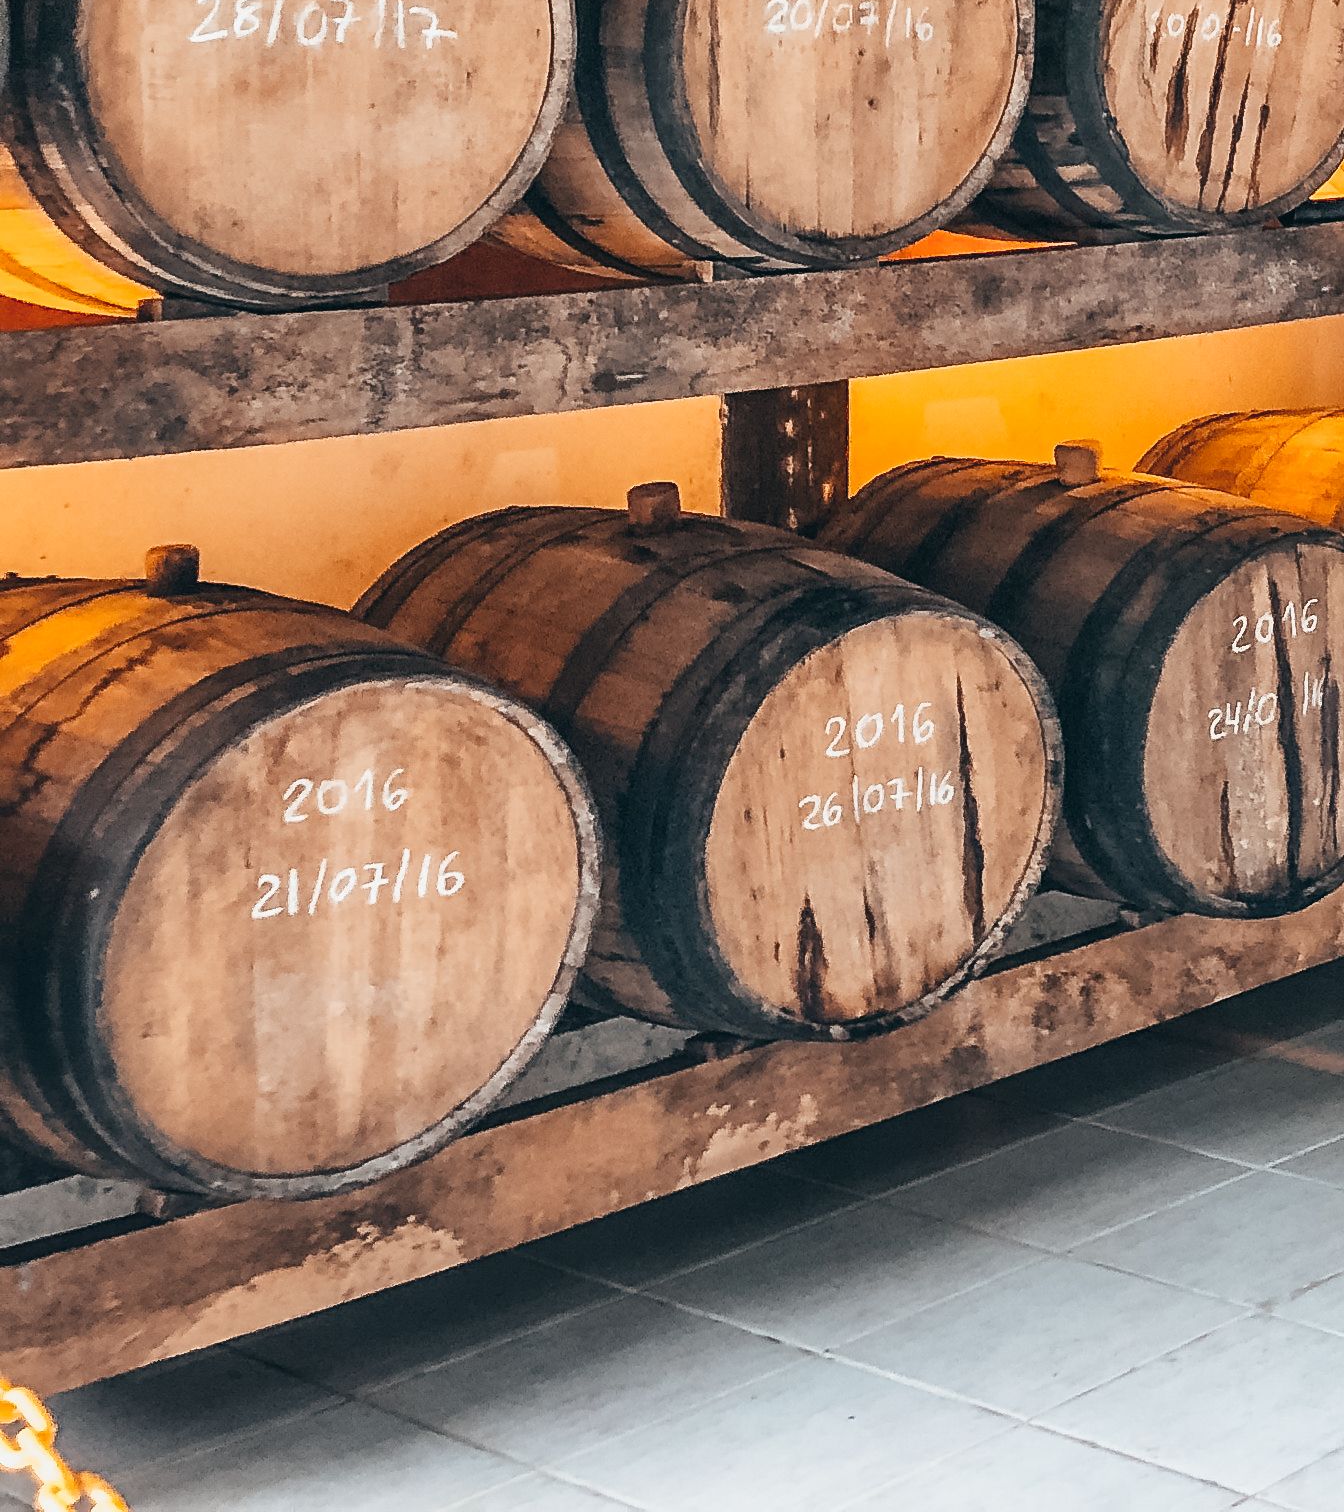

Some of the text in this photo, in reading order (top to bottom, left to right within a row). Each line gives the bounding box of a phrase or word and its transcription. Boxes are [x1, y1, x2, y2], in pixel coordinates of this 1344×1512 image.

[1231, 598, 1319, 654] 2016
[825, 701, 935, 758] 2016
[281, 768, 409, 823] 2016
[798, 766, 955, 831] 26/07/16
[251, 847, 465, 919] 21/07/16
